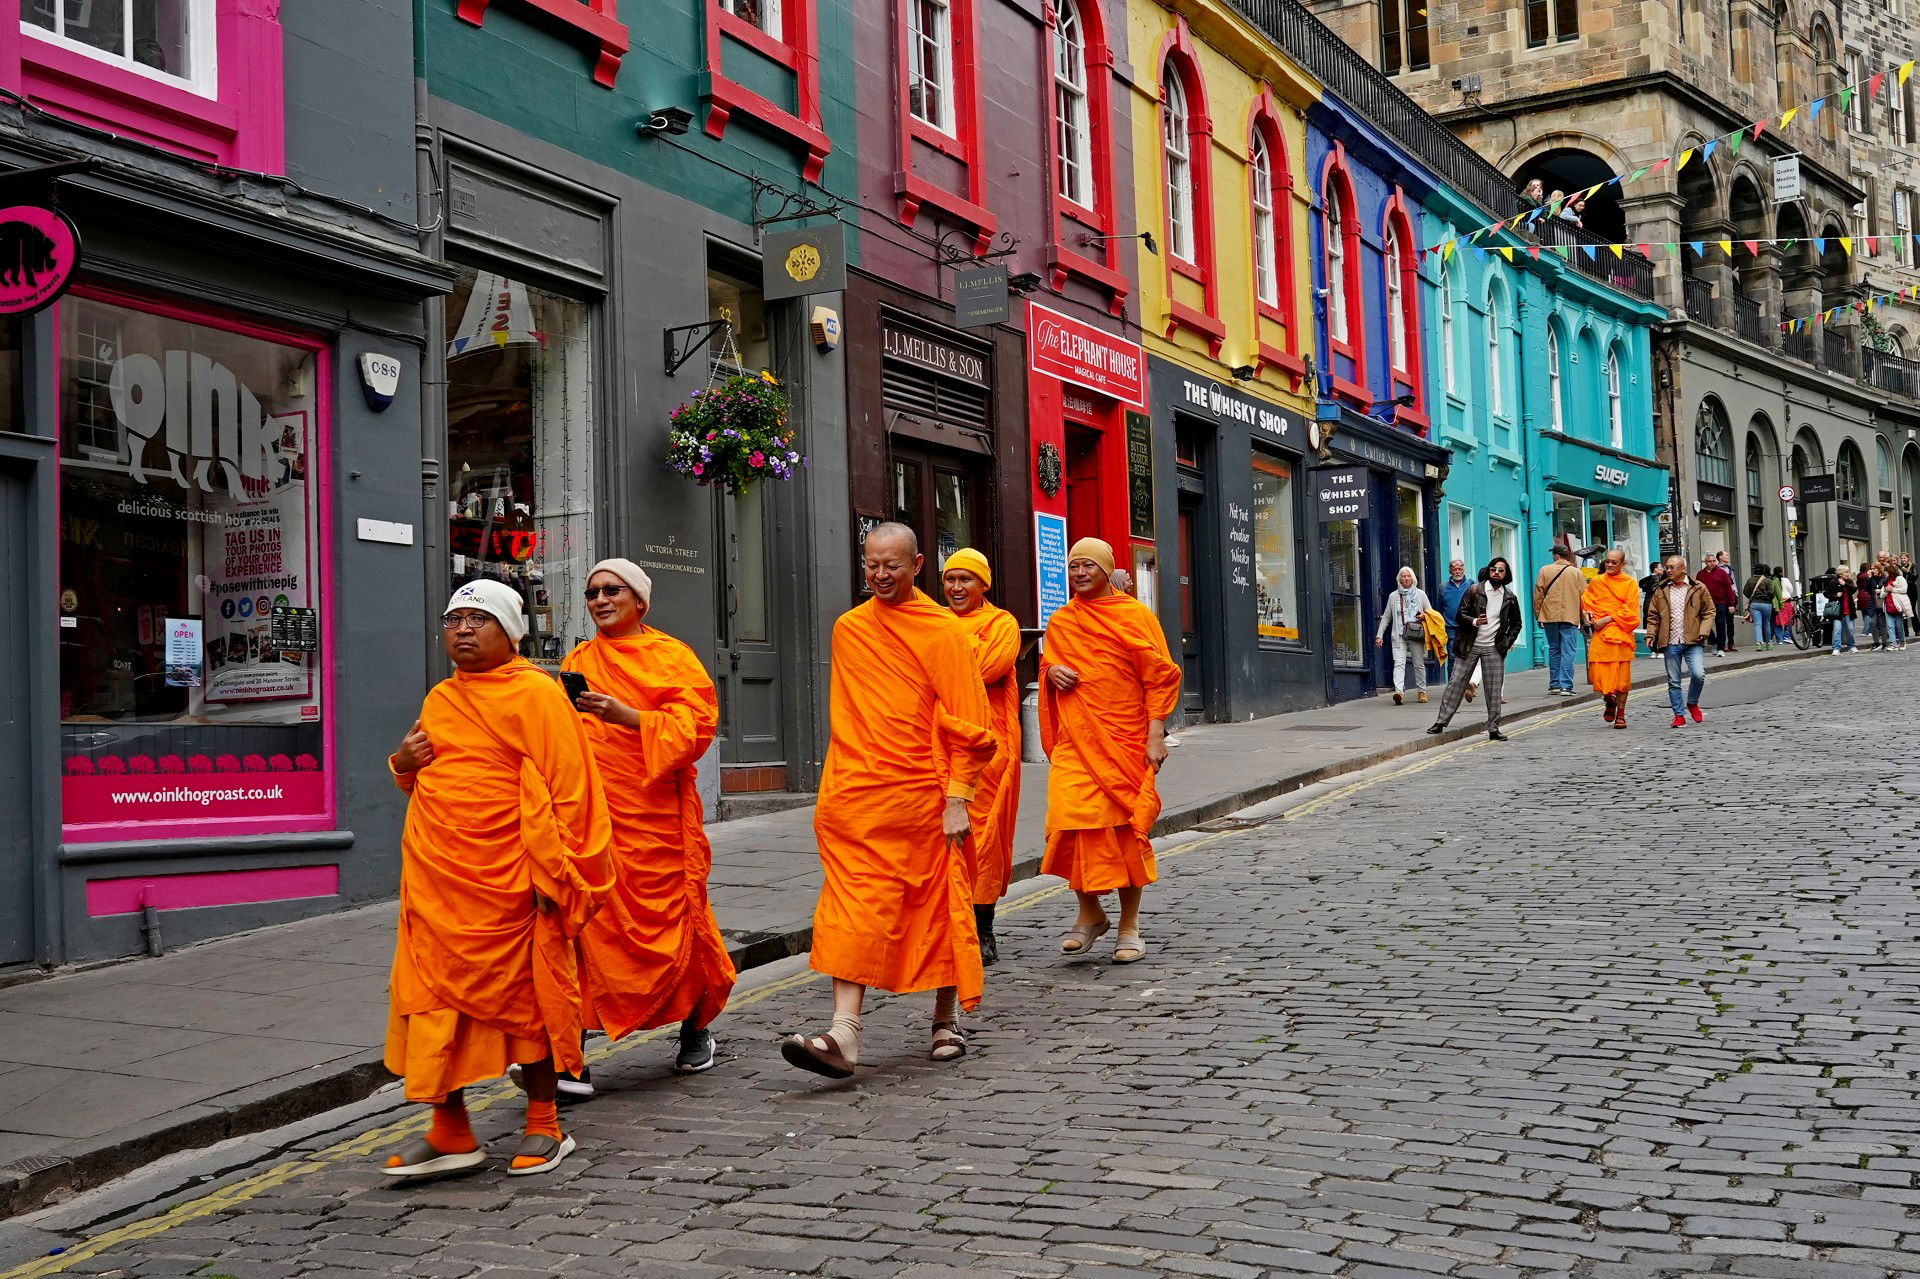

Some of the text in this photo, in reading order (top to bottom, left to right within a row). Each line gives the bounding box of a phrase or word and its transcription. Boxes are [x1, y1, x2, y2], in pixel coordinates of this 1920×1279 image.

[1038, 320, 1138, 381] The ELEPHANT HOUSE
[949, 351, 957, 372] &
[960, 354, 983, 381] SON
[1074, 365, 1095, 381] MAGICAL
[1183, 380, 1208, 408] THE
[1210, 388, 1257, 426] WHISKY
[1259, 409, 1288, 436] SHOP
[1130, 440, 1148, 455] BUTTER
[1331, 475, 1354, 484] THE
[1595, 464, 1630, 487] SWISH
[1320, 489, 1367, 501] WHISKY
[117, 500, 172, 519] delicious
[175, 508, 222, 525] scottish
[240, 510, 260, 518] chance
[1329, 504, 1359, 515] SHOP
[225, 528, 281, 547] TAG US IN
[225, 542, 282, 557] YOUR PHOTOS
[645, 544, 698, 558] VICTORIA STREET
[225, 552, 282, 567] OF YOUR OINK
[640, 560, 705, 574] EDINBURGHSKINCARE.COM
[225, 562, 282, 578] EXPERIENCE
[209, 574, 298, 597] #posewiththepig
[174, 631, 194, 639] OPEN
[220, 683, 294, 695] www.oinkhogroast.co.uk
[111, 785, 283, 806] www.oinkhogroast.co.uk
